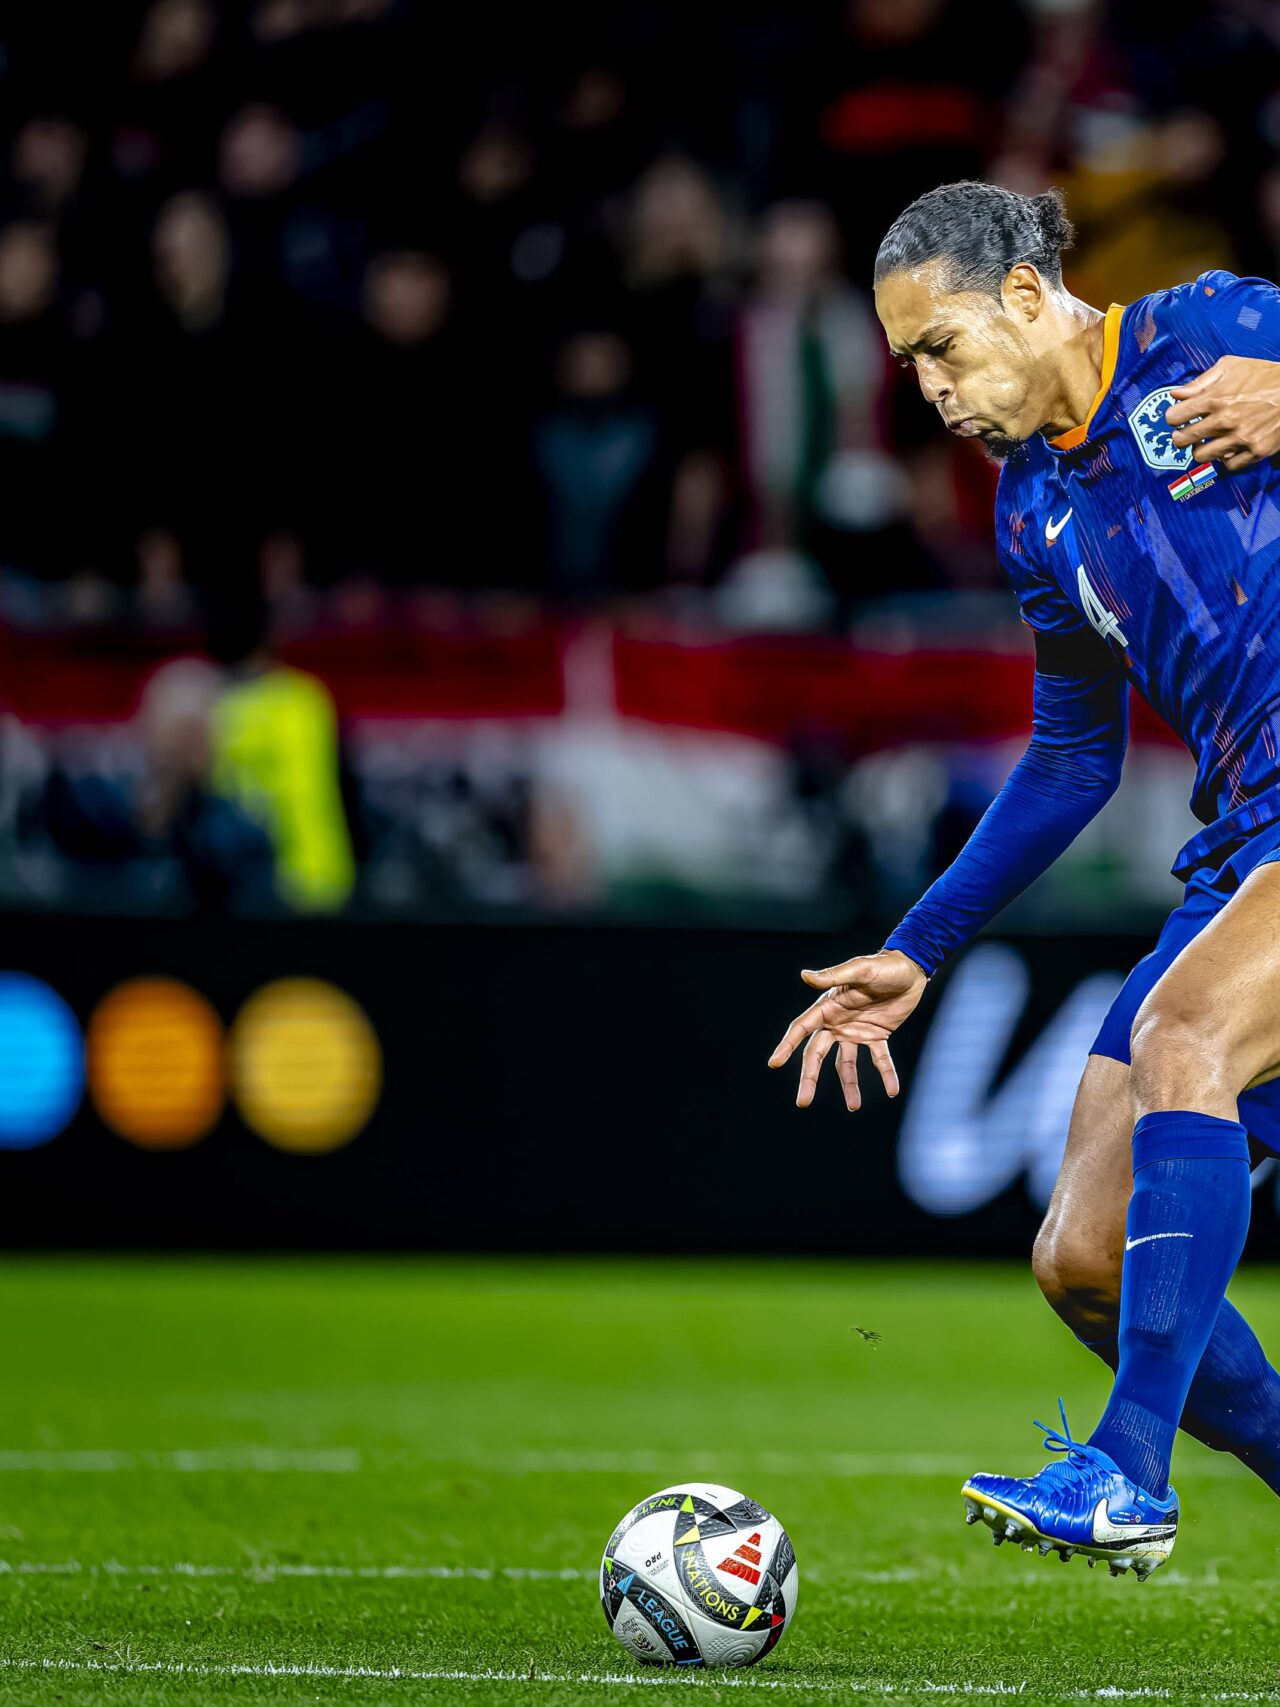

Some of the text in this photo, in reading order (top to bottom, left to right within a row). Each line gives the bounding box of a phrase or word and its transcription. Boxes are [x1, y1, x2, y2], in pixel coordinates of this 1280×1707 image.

[1077, 563, 1129, 648] 4
[645, 1551, 662, 1568] PRO
[684, 1555, 740, 1621] NATIONS
[637, 1589, 689, 1650] LEAGUE
